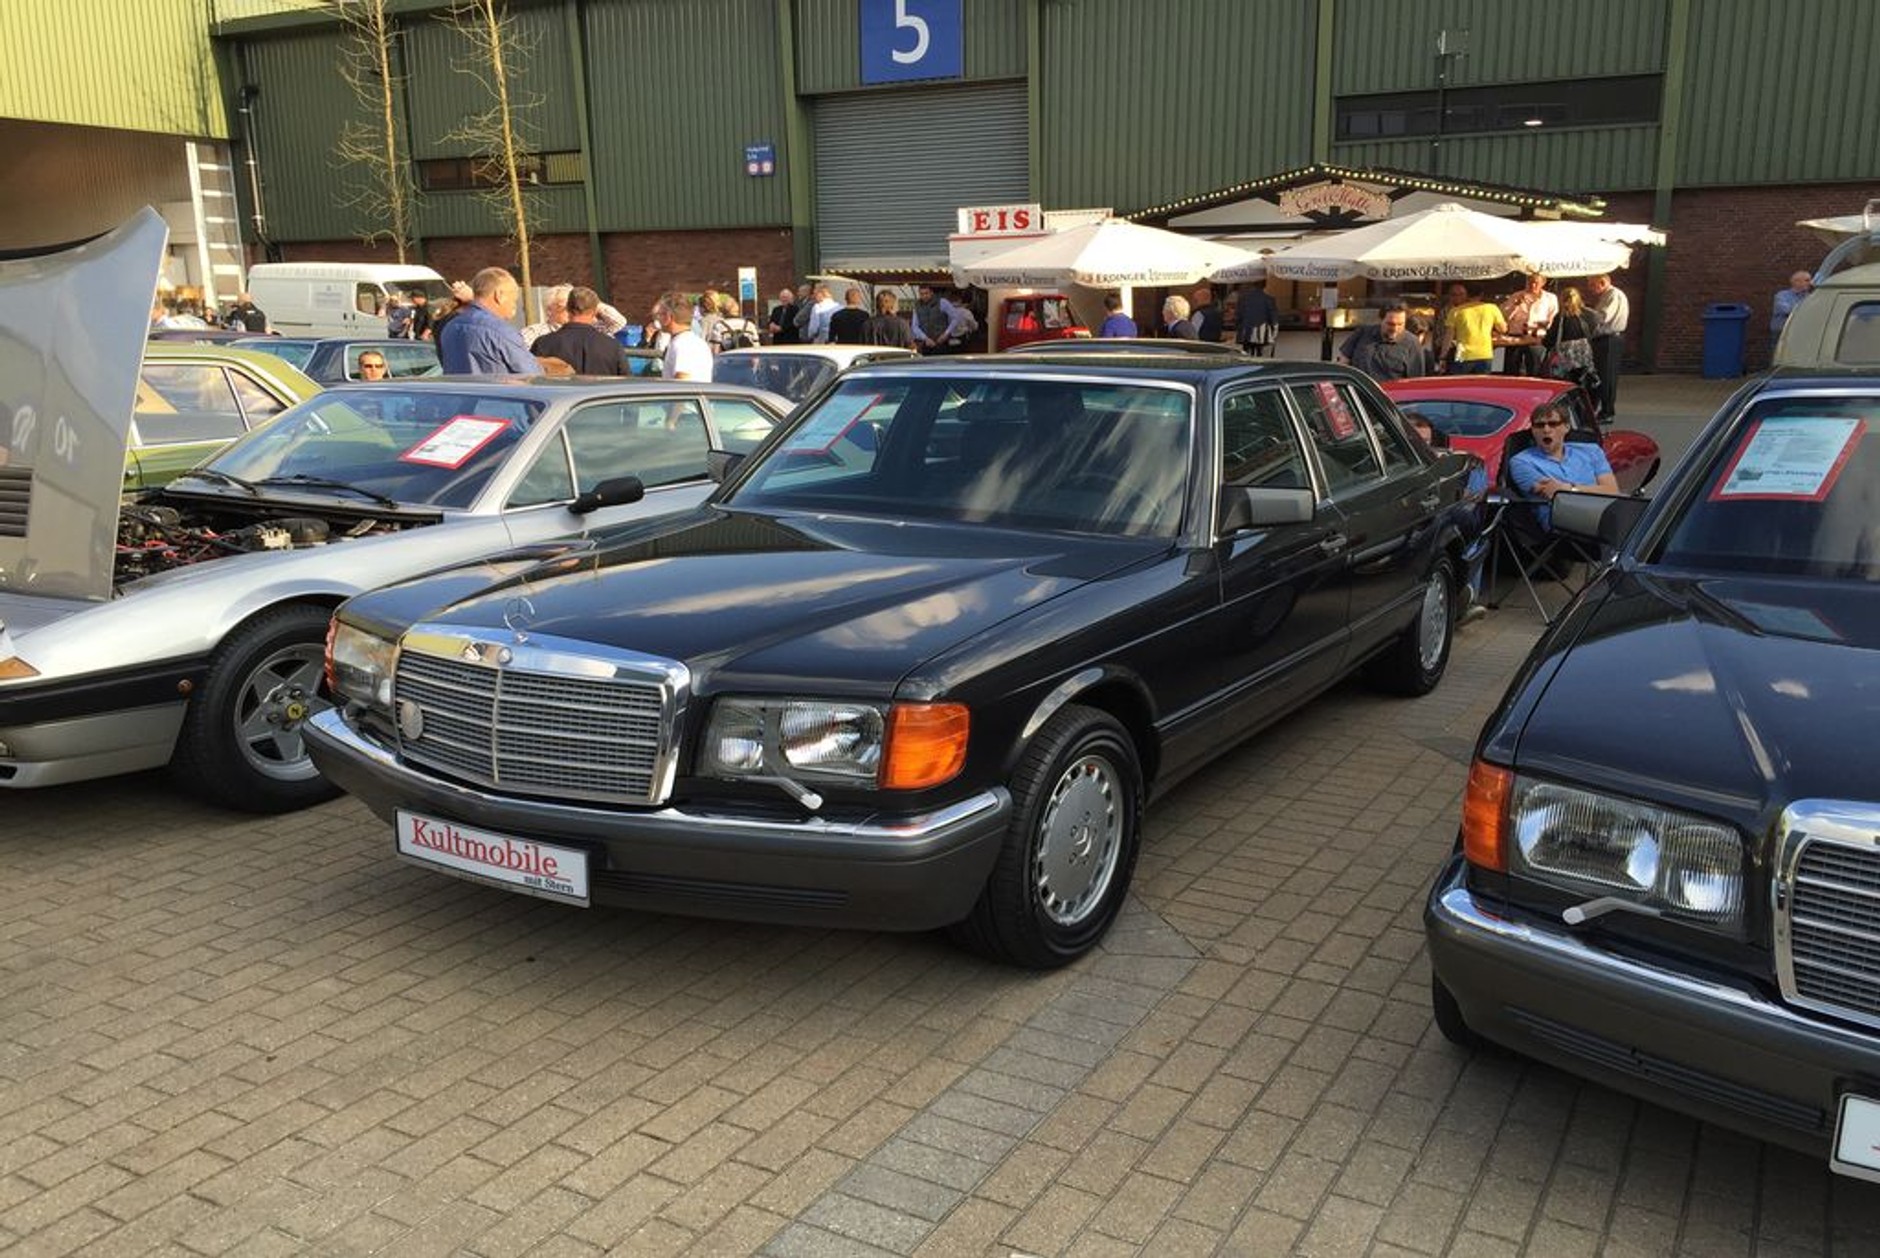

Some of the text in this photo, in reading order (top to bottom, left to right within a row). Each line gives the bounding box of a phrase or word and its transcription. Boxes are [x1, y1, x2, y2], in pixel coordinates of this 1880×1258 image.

[892, 0, 929, 64] 5
[973, 210, 1030, 232] EIS
[1096, 271, 1147, 284] ERDINGER
[1381, 265, 1439, 280] ERDINGER
[411, 817, 559, 877] Kultmobile
[523, 875, 574, 894] mit Stern
